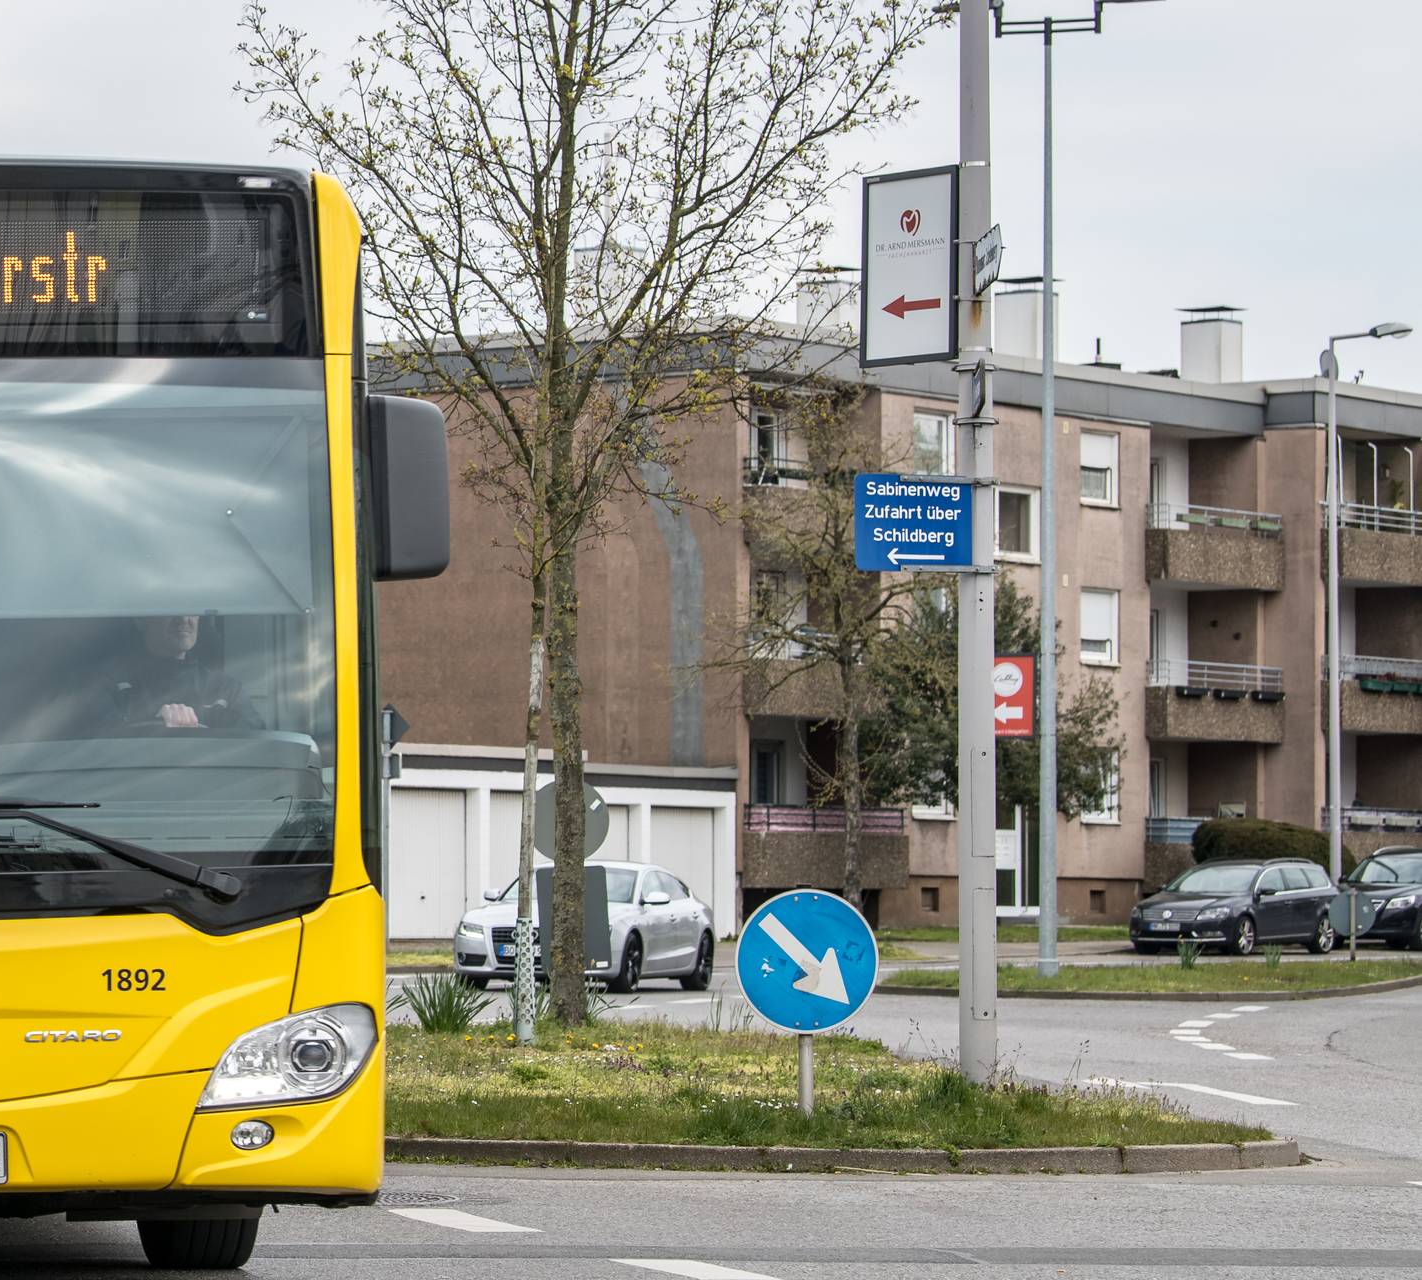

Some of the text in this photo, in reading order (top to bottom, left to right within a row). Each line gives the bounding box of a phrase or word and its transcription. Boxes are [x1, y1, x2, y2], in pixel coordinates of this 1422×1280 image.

[888, 241, 907, 250] ARND
[907, 237, 945, 248] MERSMANN
[866, 481, 961, 502] Sabinenweg
[864, 504, 962, 521] Zufahrt über
[873, 527, 955, 547] Schildberg
[101, 968, 166, 992] 1892
[24, 1029, 123, 1044] CITARO
